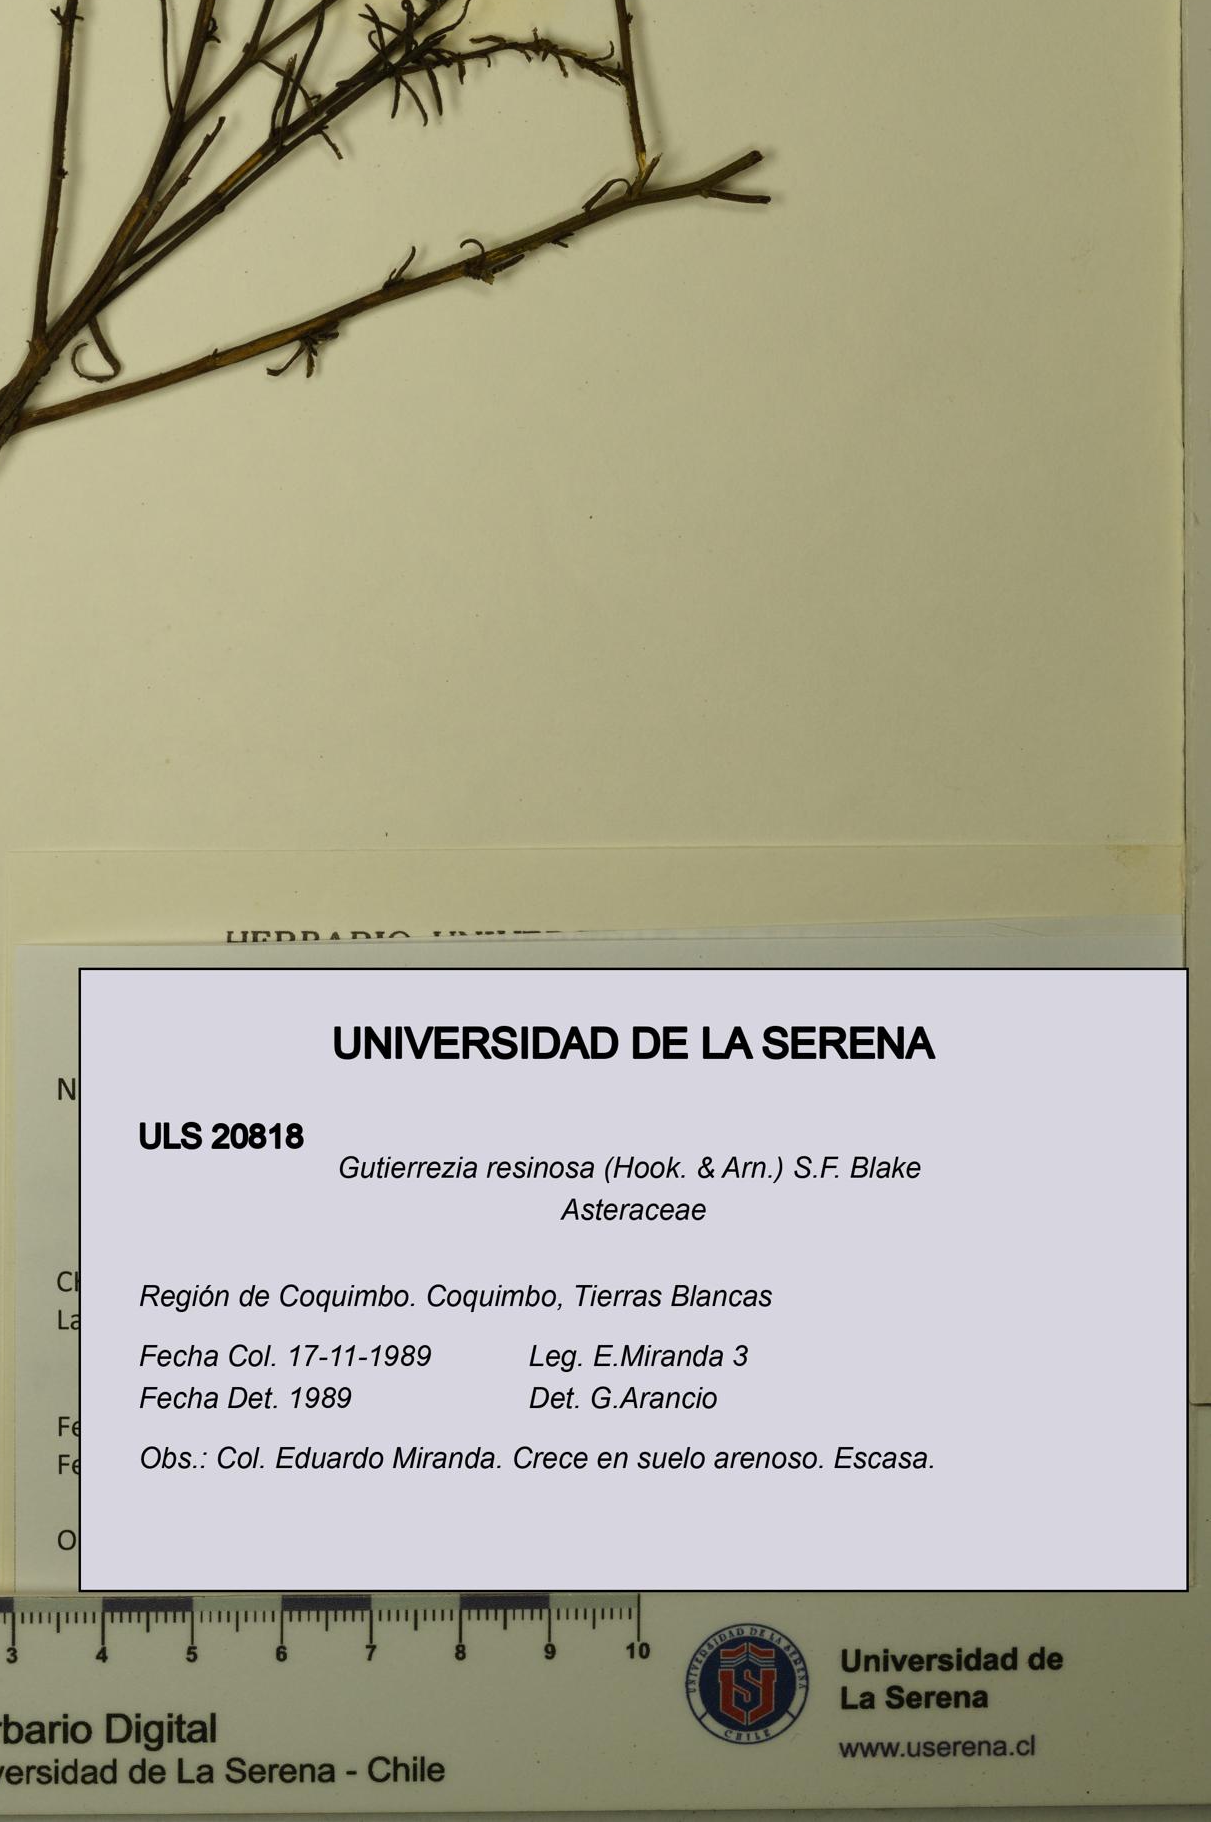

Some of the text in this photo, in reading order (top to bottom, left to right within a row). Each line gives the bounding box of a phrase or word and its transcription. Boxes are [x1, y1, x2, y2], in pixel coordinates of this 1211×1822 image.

[6, 1647, 18, 1664] 3
[95, 1647, 108, 1663] 4
[185, 1646, 198, 1663] 5
[275, 1645, 287, 1662] 6
[365, 1645, 377, 1661] 7
[454, 1644, 466, 1660] 8
[544, 1643, 556, 1660] 9
[626, 1642, 650, 1659] 10
[842, 1647, 1063, 1673] Universidad de
[841, 1685, 988, 1710] La Serena
[105, 1713, 217, 1751] Digital
[839, 1735, 1035, 1758] www.userena.cl
[129, 1758, 166, 1784] de
[178, 1758, 213, 1784] La
[225, 1757, 335, 1784] Serena
[368, 1756, 445, 1783] Chile
